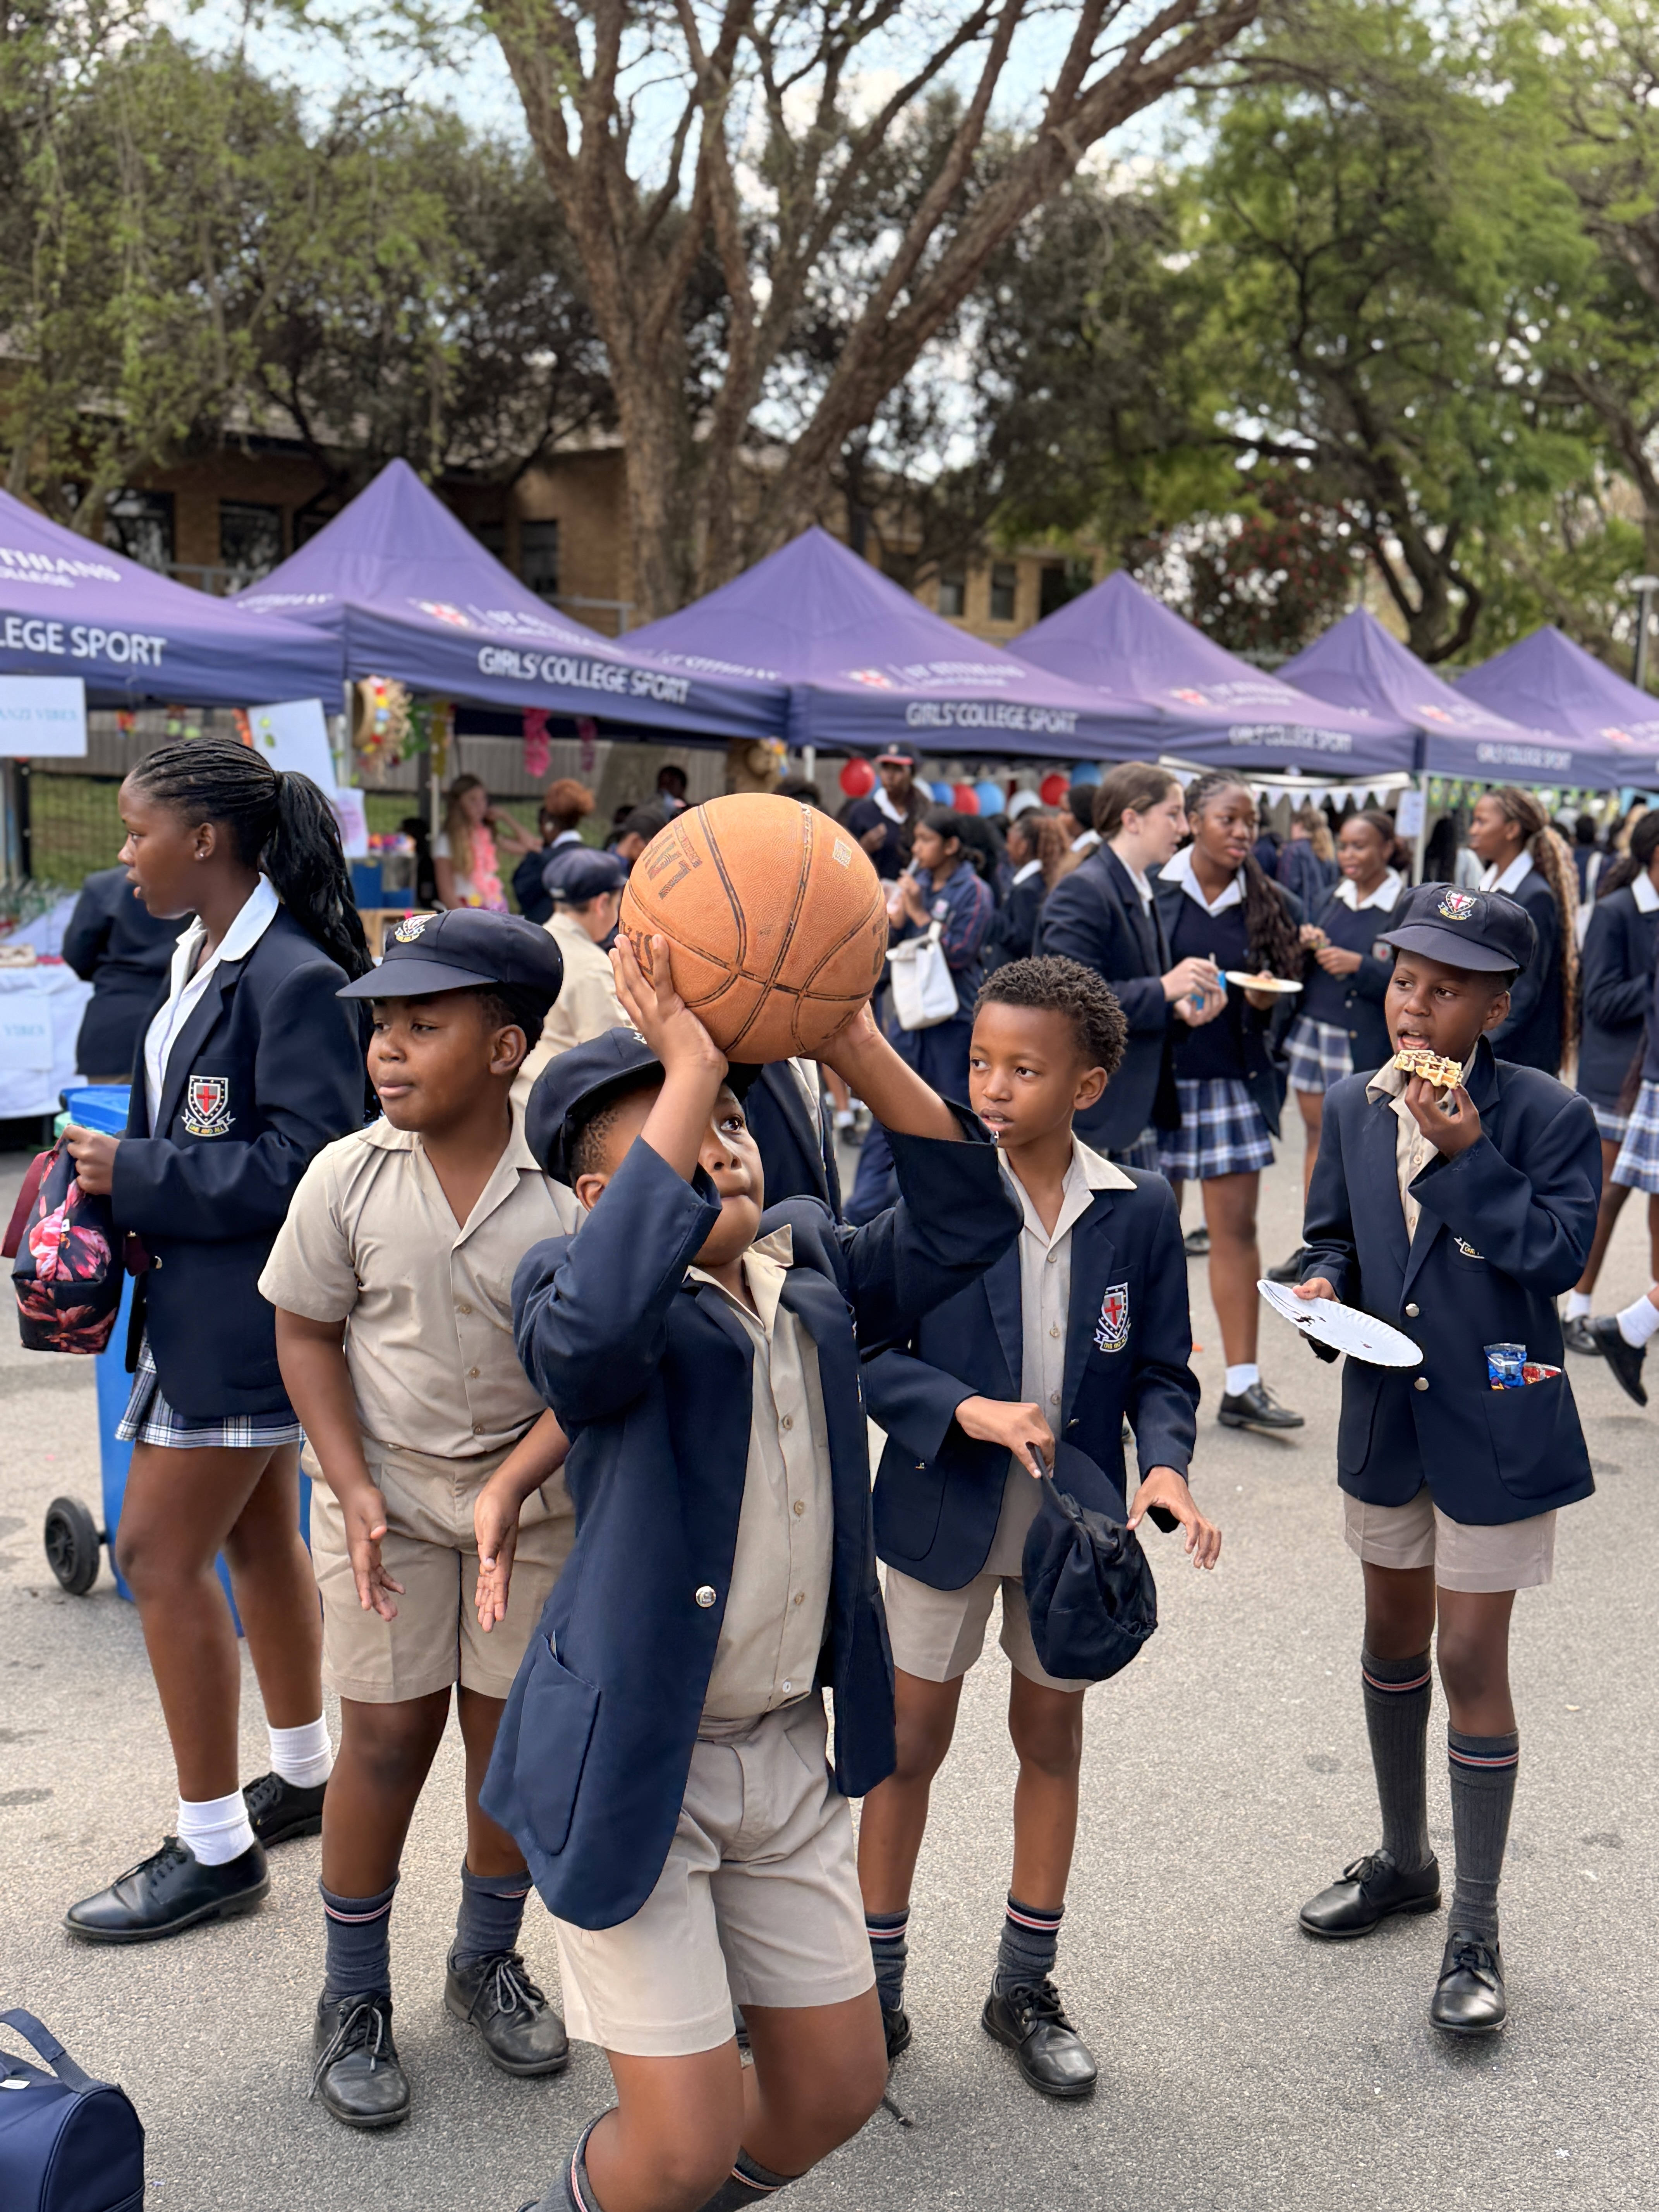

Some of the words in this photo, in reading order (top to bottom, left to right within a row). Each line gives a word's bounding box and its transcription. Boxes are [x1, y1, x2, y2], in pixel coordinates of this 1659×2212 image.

[70, 625, 167, 666] SPORT
[541, 655, 628, 694] COLLEGE
[630, 669, 691, 704] SPORT
[955, 702, 1027, 730] COLLEGE
[1028, 707, 1079, 735] SPORT
